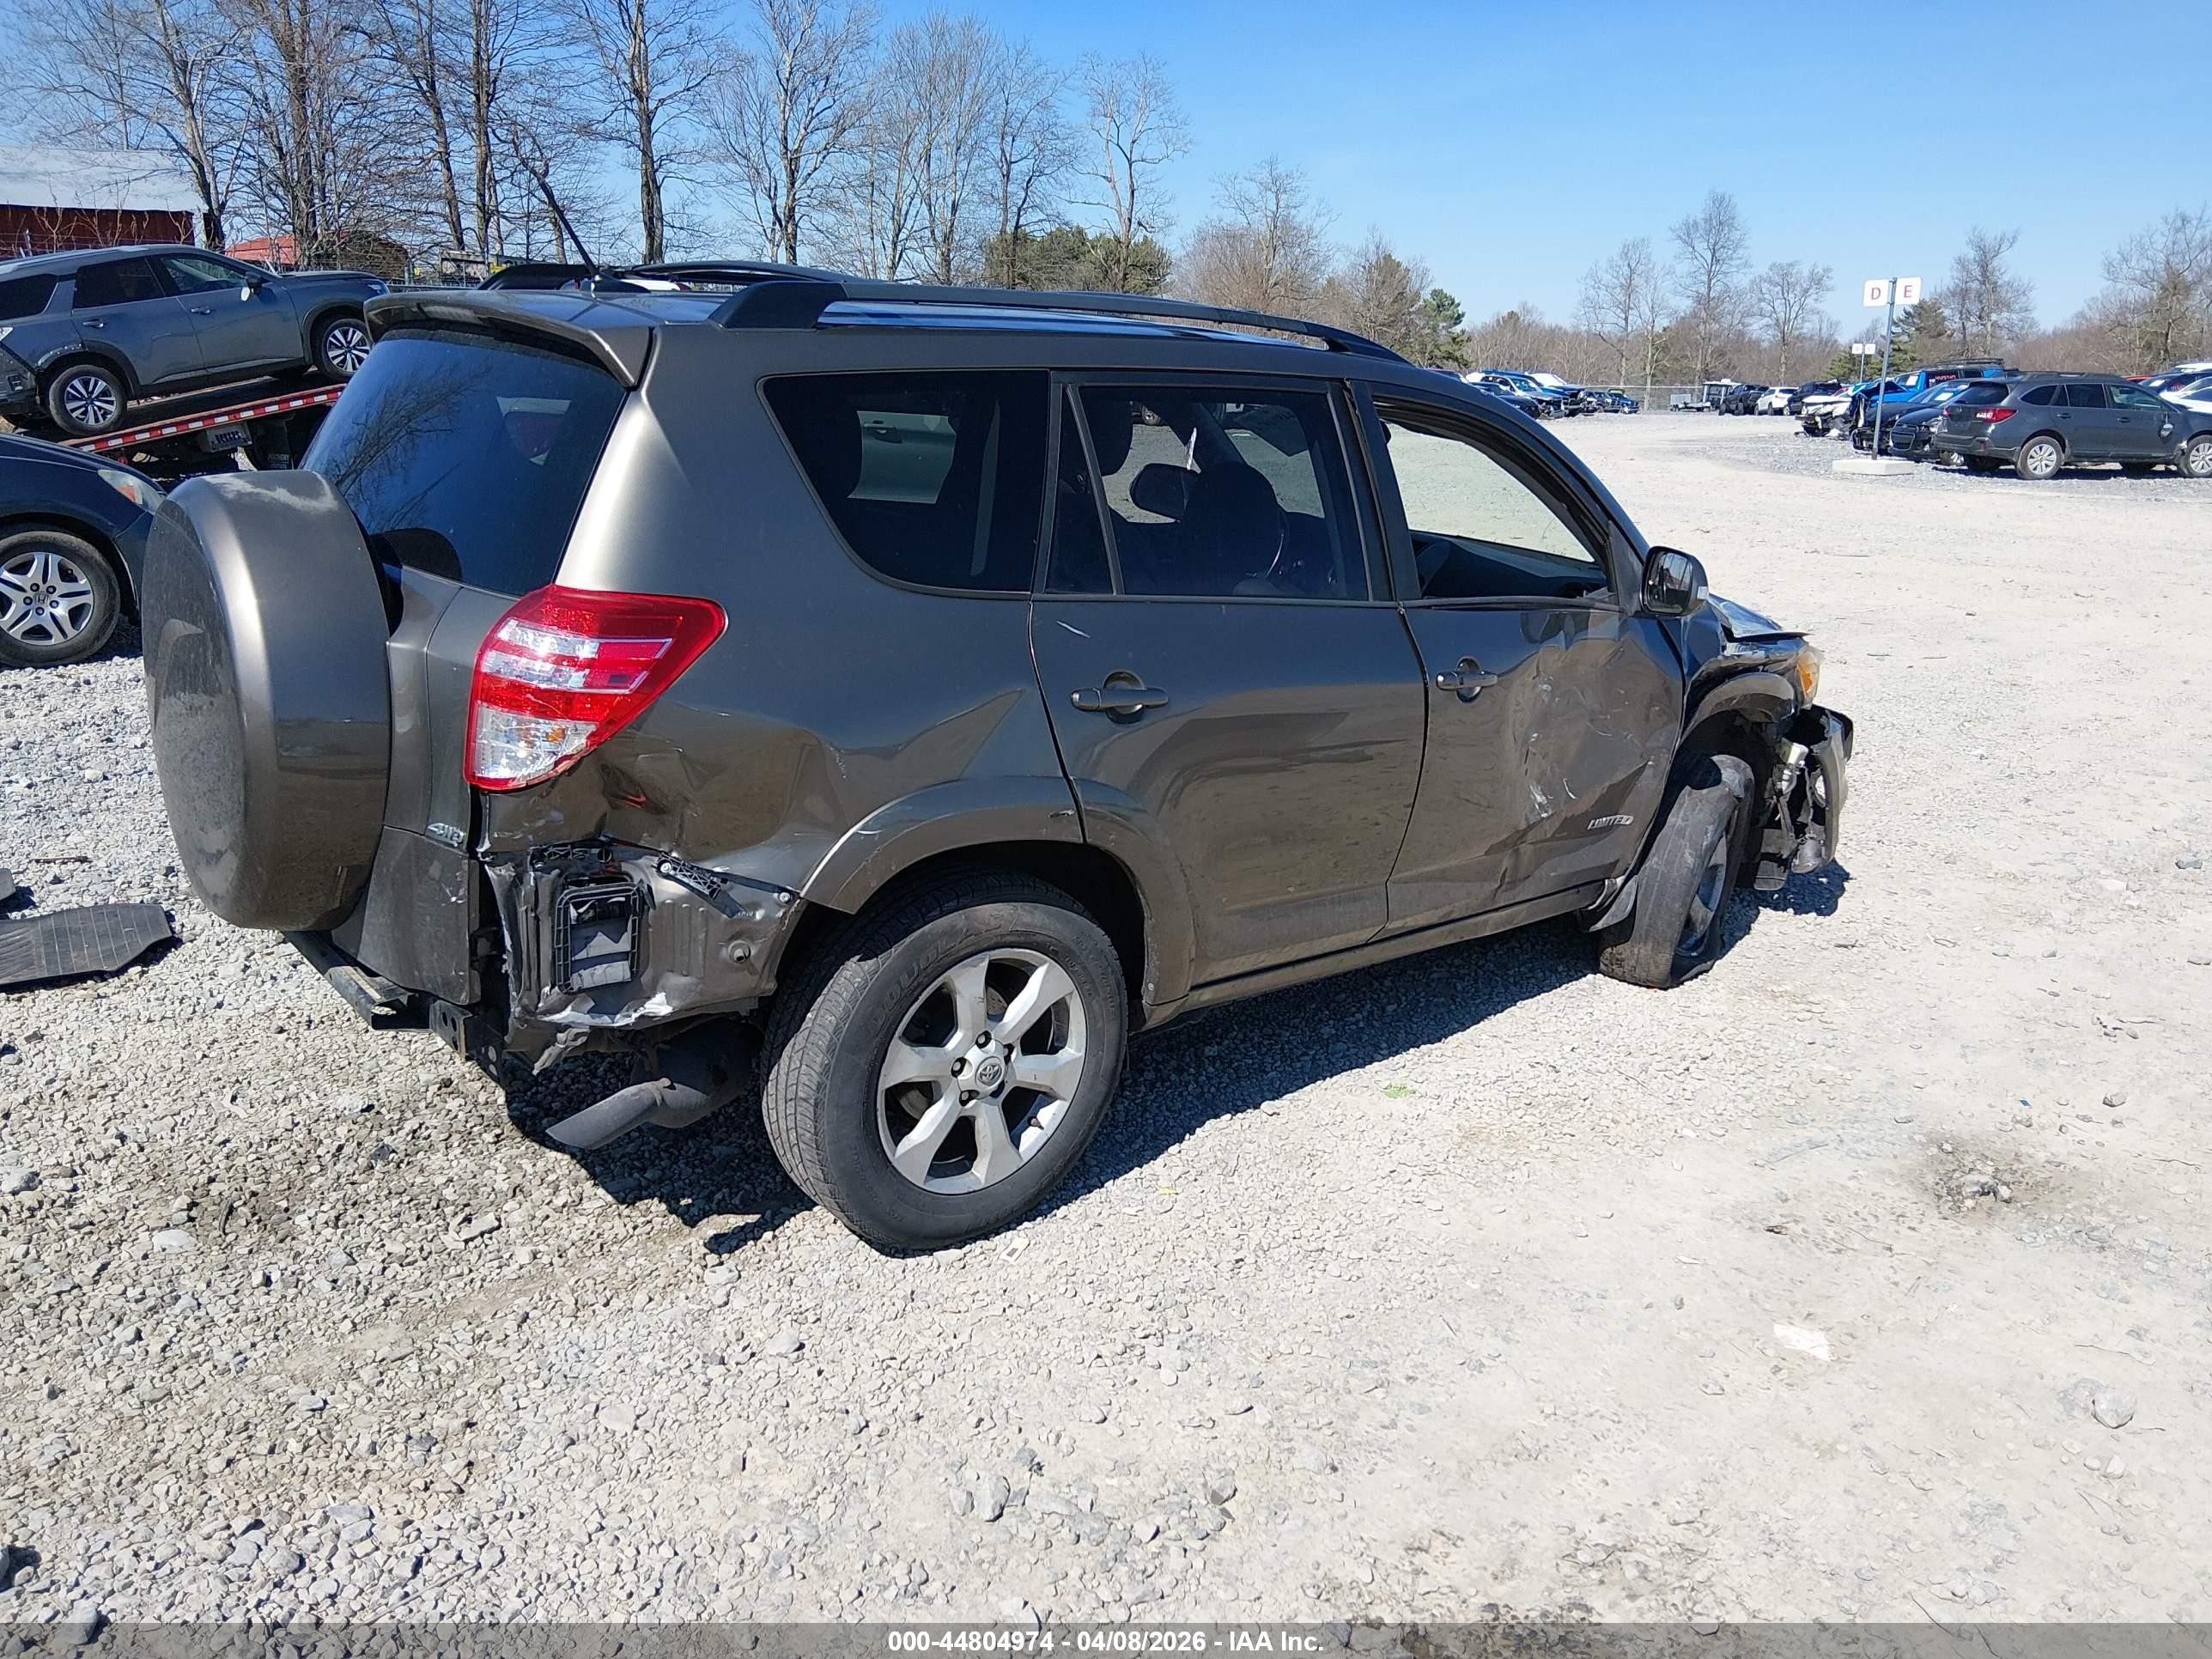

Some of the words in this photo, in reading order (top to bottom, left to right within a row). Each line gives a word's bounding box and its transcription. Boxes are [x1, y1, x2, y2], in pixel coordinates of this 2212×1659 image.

[1871, 287, 1881, 300] D
[1904, 284, 1913, 298] E
[1586, 813, 1634, 830] LIMITED
